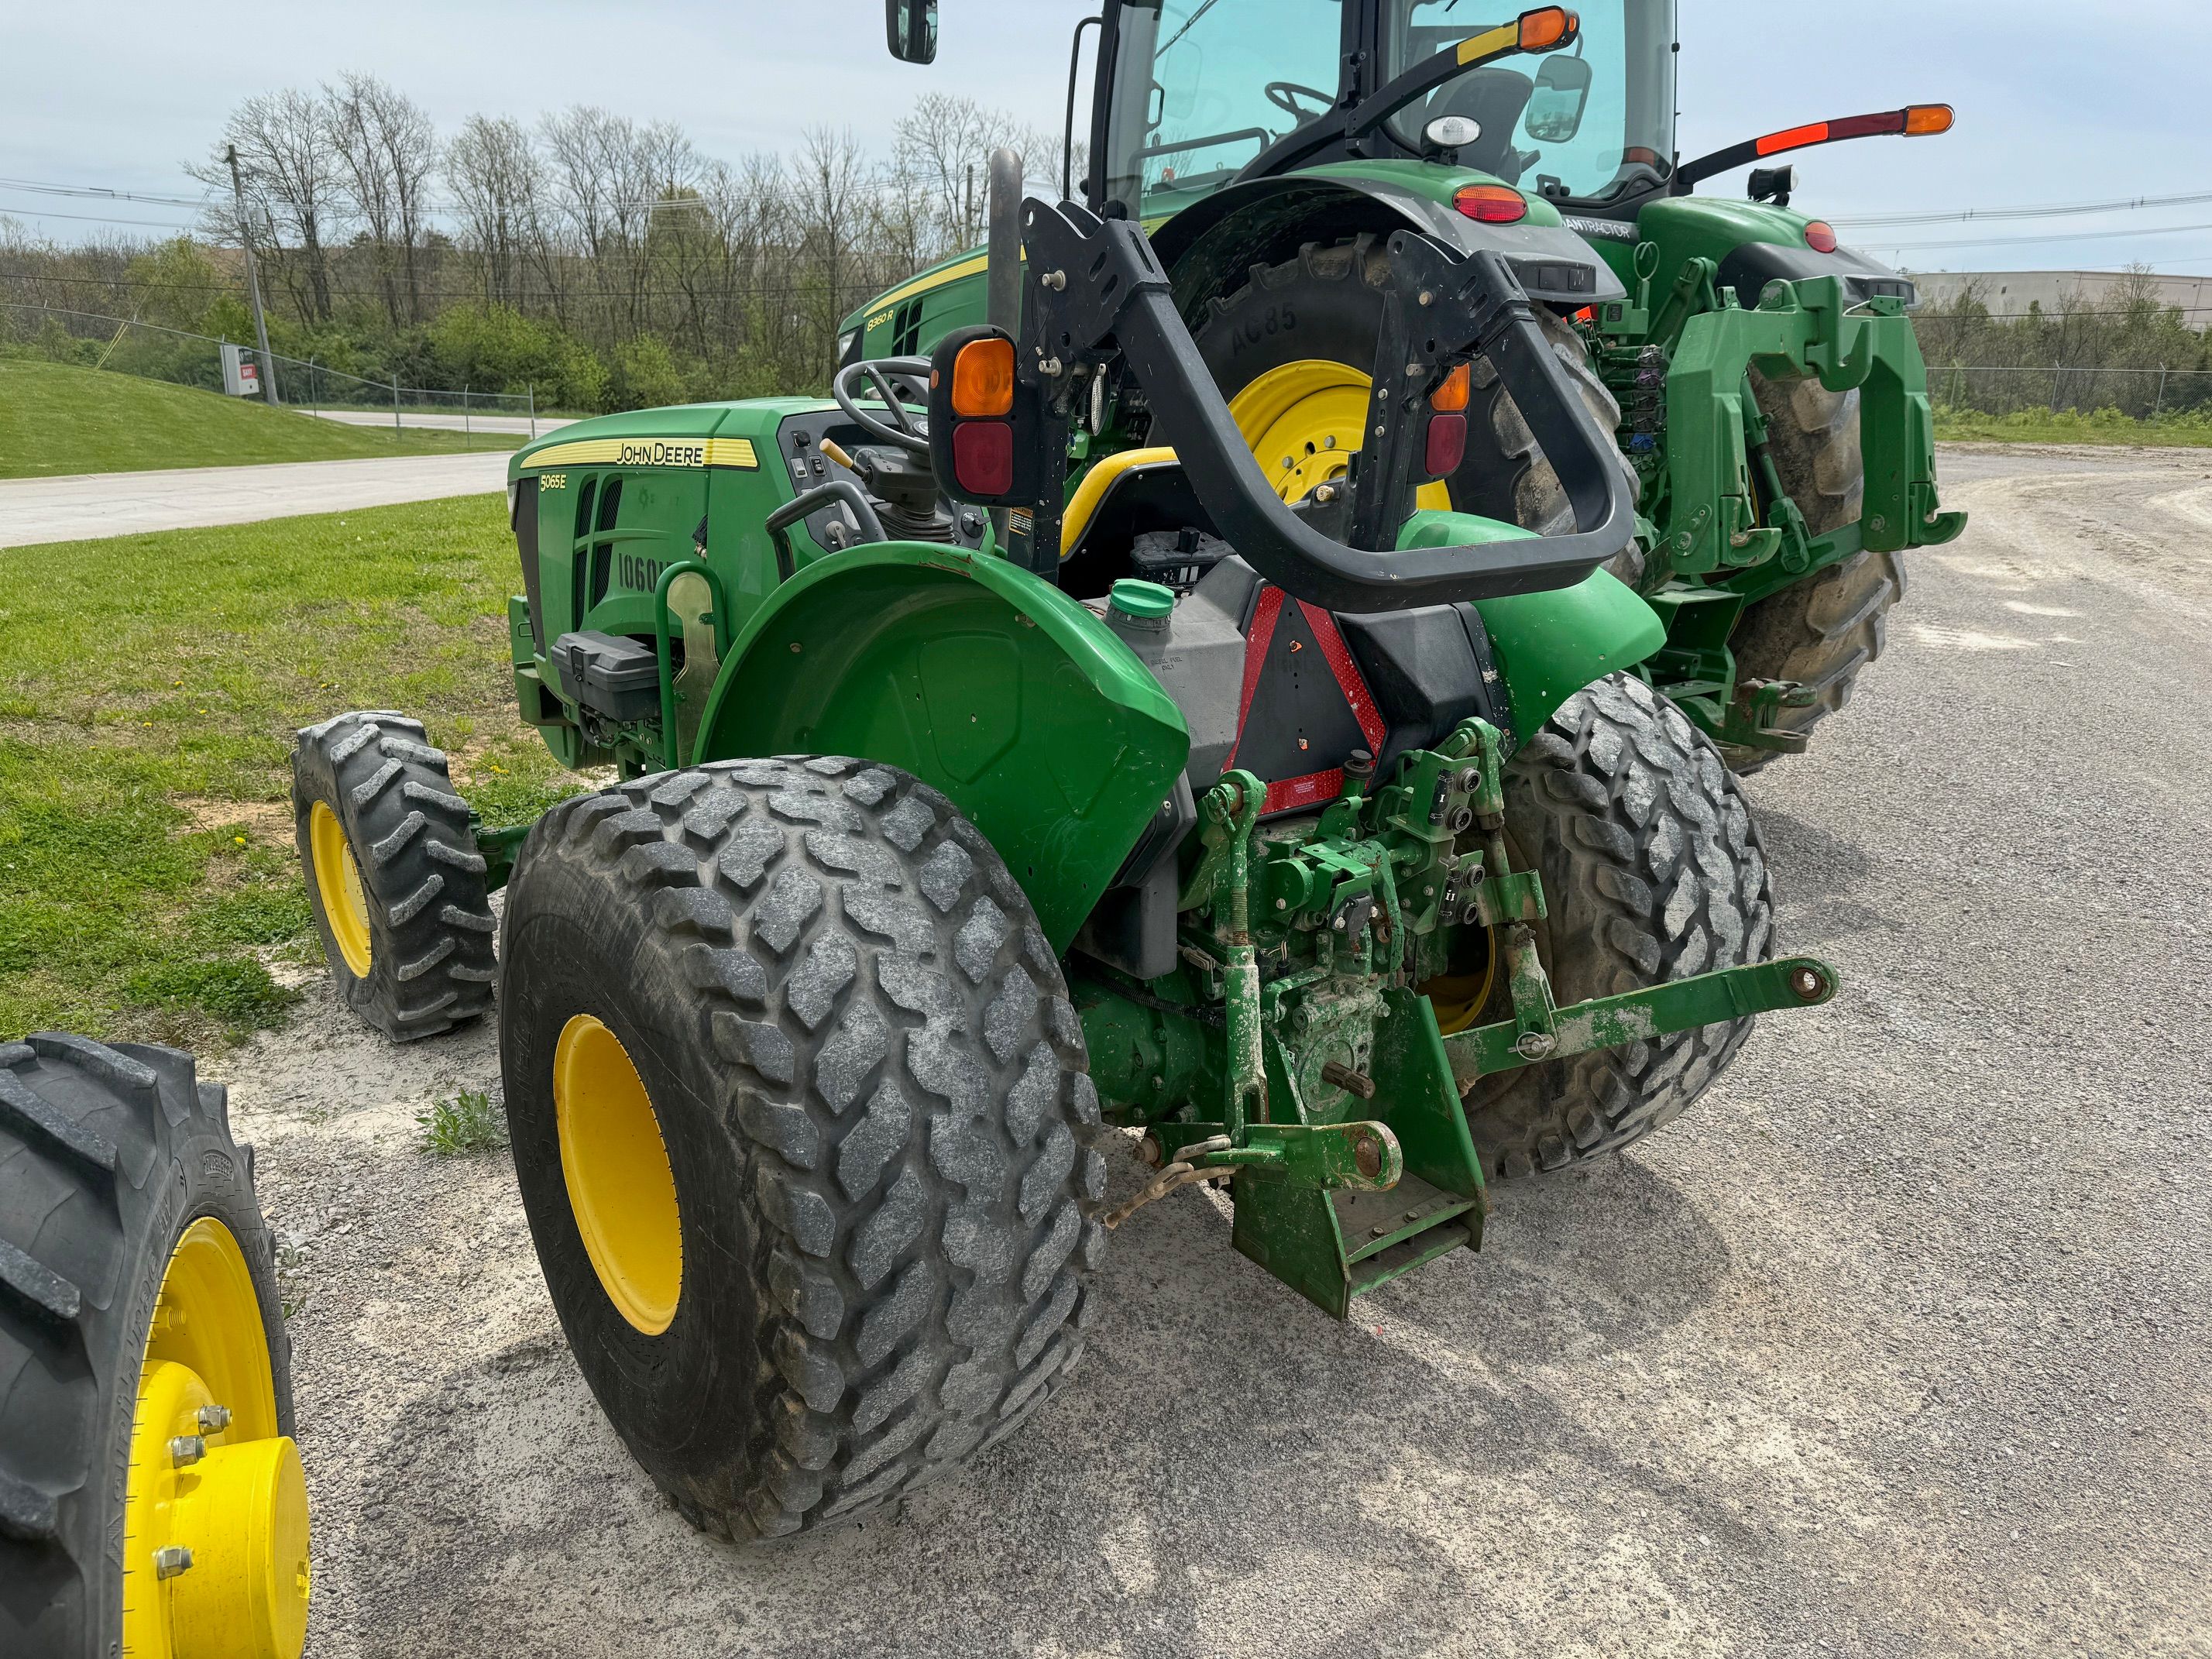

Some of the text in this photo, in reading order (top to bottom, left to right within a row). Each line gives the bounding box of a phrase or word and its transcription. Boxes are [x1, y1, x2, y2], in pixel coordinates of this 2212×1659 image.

[617, 442, 703, 464] JOHN DEERE
[540, 474, 567, 492] 5065E
